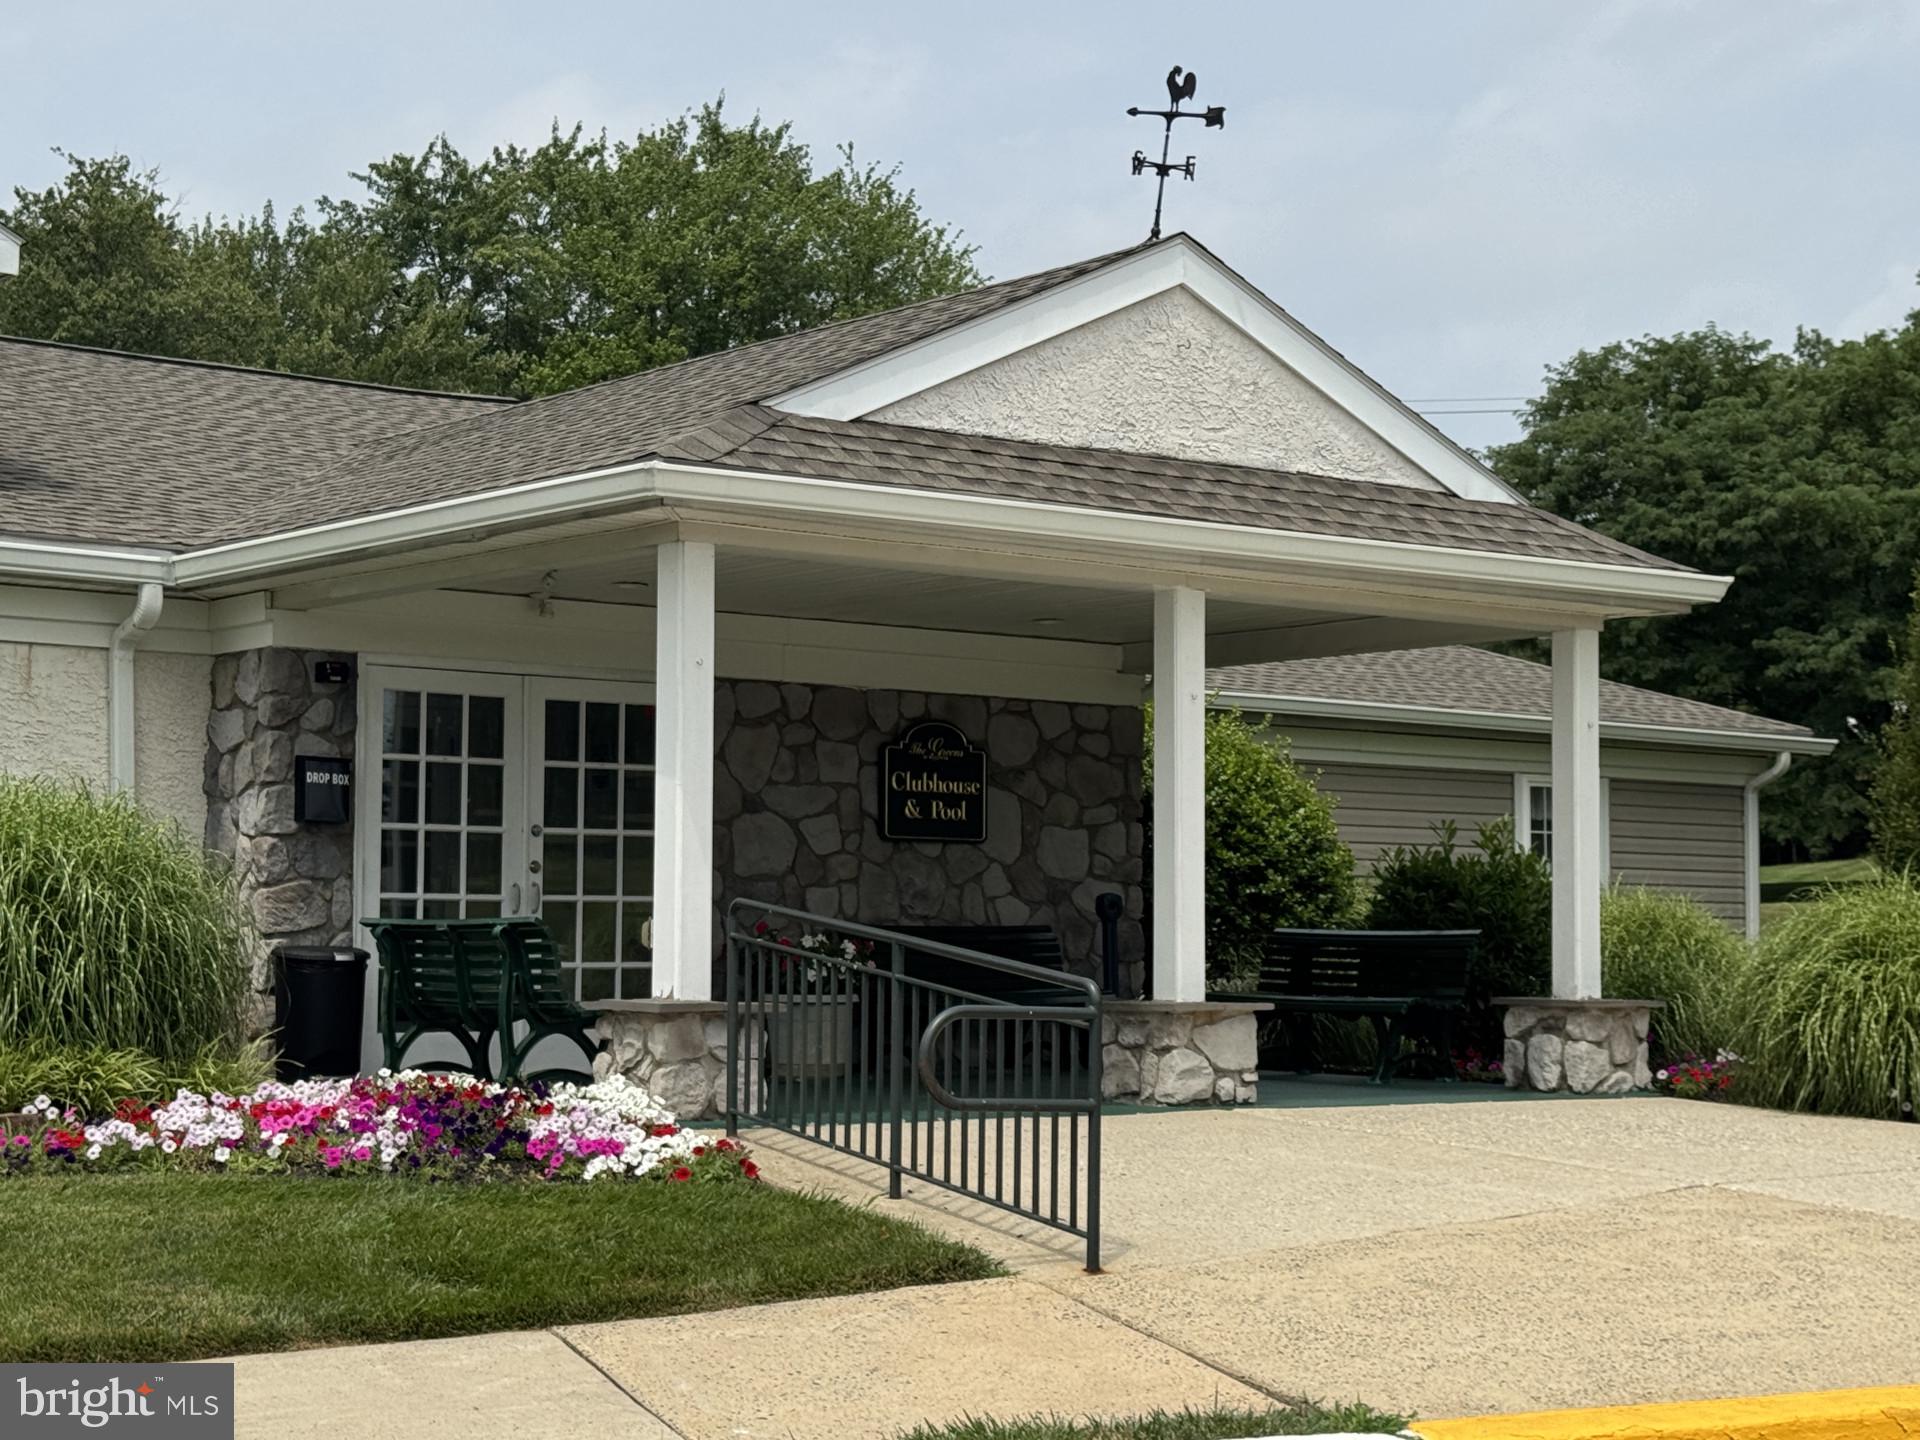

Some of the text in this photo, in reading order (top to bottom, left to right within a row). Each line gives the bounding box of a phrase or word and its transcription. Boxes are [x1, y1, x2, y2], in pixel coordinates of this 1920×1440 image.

[306, 771, 350, 786] DROP BOX
[891, 770, 981, 796] Clubhouse
[904, 798, 968, 821] & Pool
